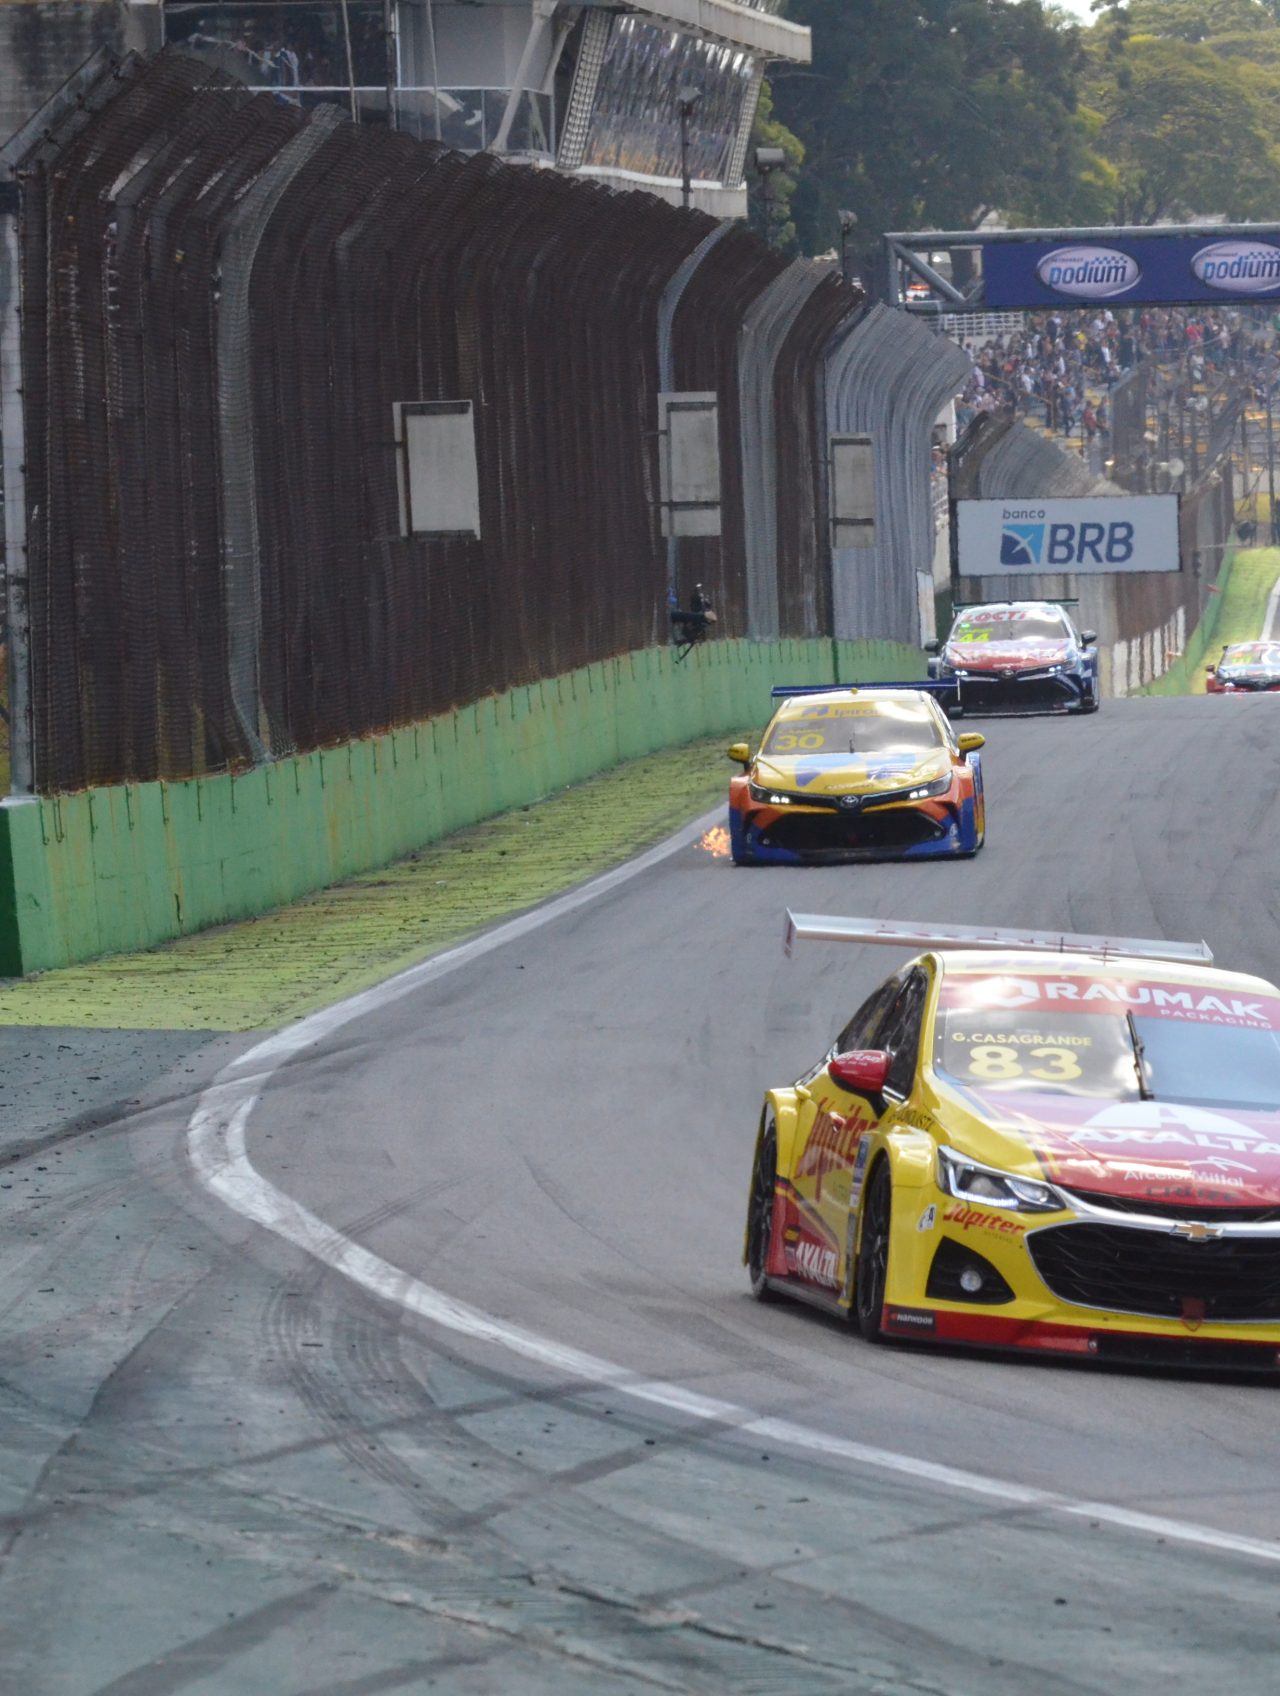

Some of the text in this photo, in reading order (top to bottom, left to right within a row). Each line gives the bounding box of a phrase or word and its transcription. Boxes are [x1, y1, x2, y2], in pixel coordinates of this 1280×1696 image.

[1049, 260, 1129, 286] podium
[1002, 508, 1046, 520] banco
[1048, 521, 1134, 565] BRB
[962, 610, 1029, 623] LOCTI
[959, 632, 990, 643] 44
[774, 733, 825, 750] 30
[1045, 982, 1268, 1020] RAUMAK
[1160, 1009, 1272, 1030] PACKAGING
[952, 1032, 1092, 1047] G.CASAGRANDE
[968, 1045, 1083, 1081] 83
[943, 1202, 1026, 1234] Jupiter
